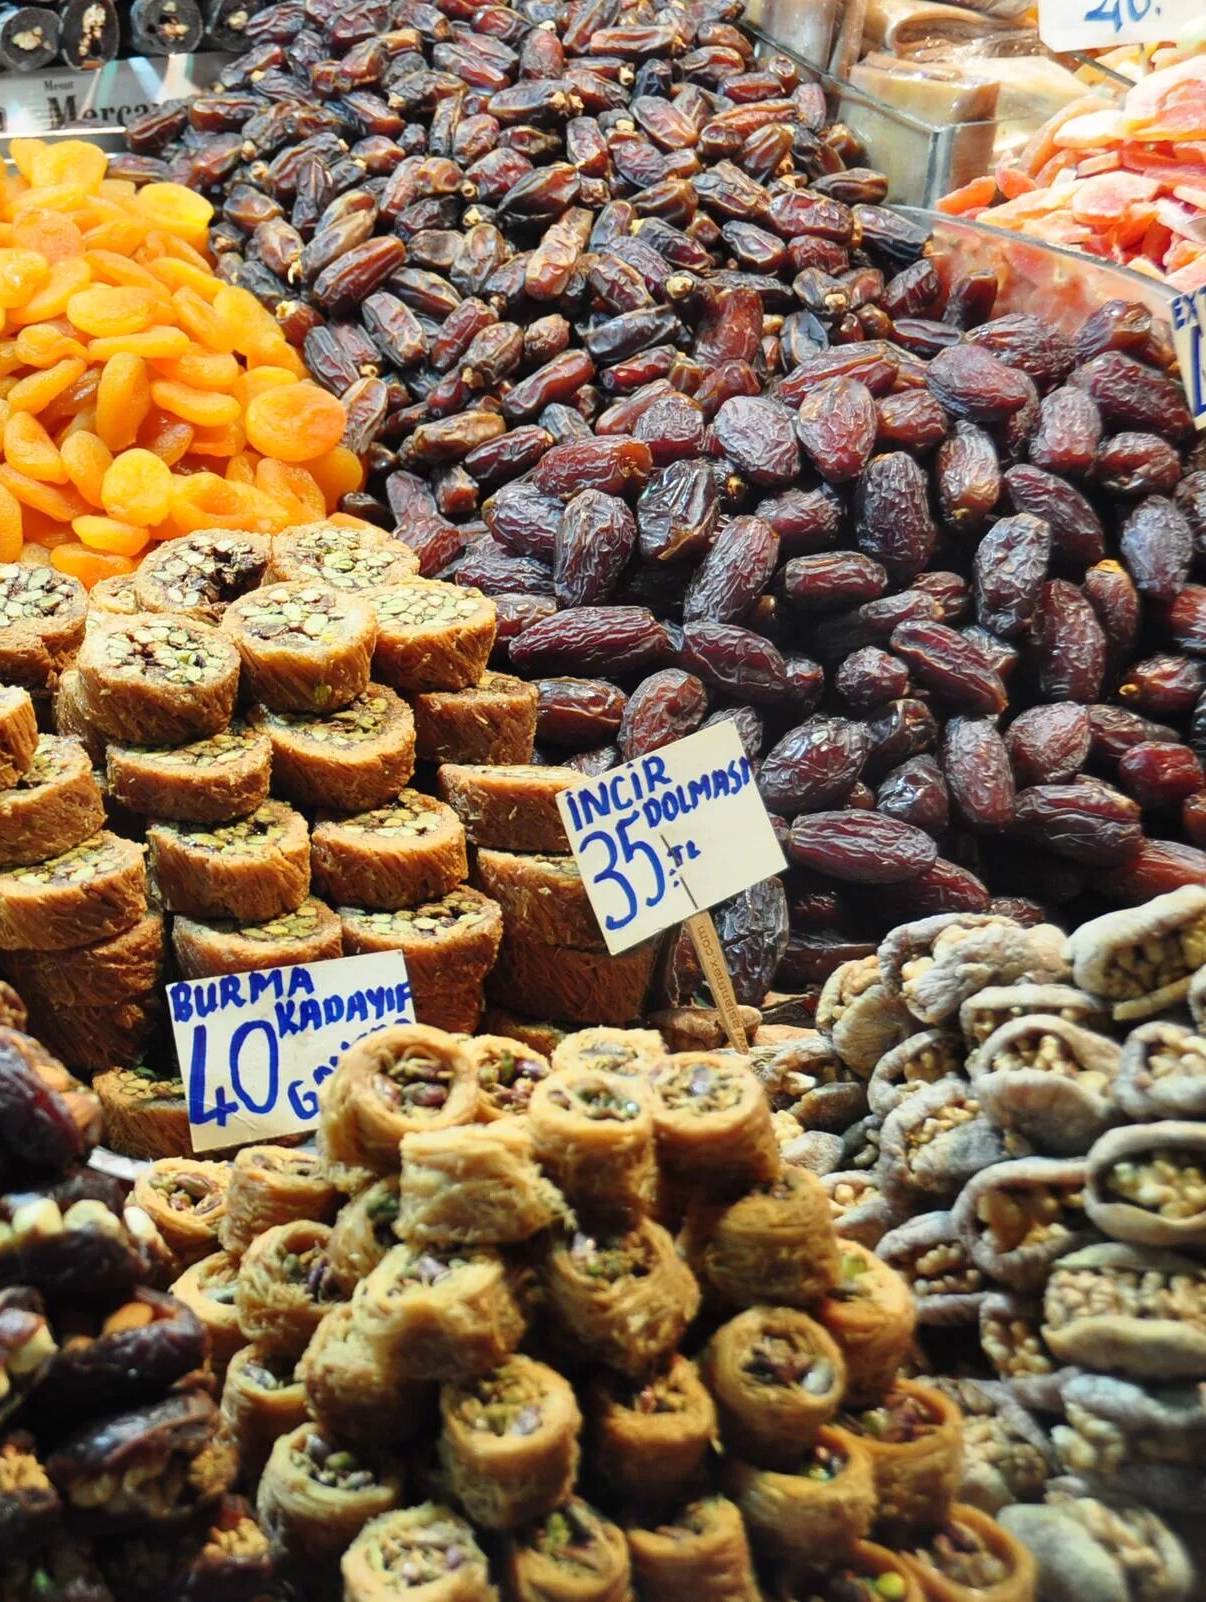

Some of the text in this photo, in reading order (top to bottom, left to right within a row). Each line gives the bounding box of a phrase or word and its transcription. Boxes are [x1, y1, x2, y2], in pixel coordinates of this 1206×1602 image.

[643, 756, 751, 828] DOLMASI
[579, 810, 665, 930] 35
[169, 966, 315, 1023] BURMA
[274, 981, 412, 1038] KADAYIF
[189, 1019, 279, 1127] 40
